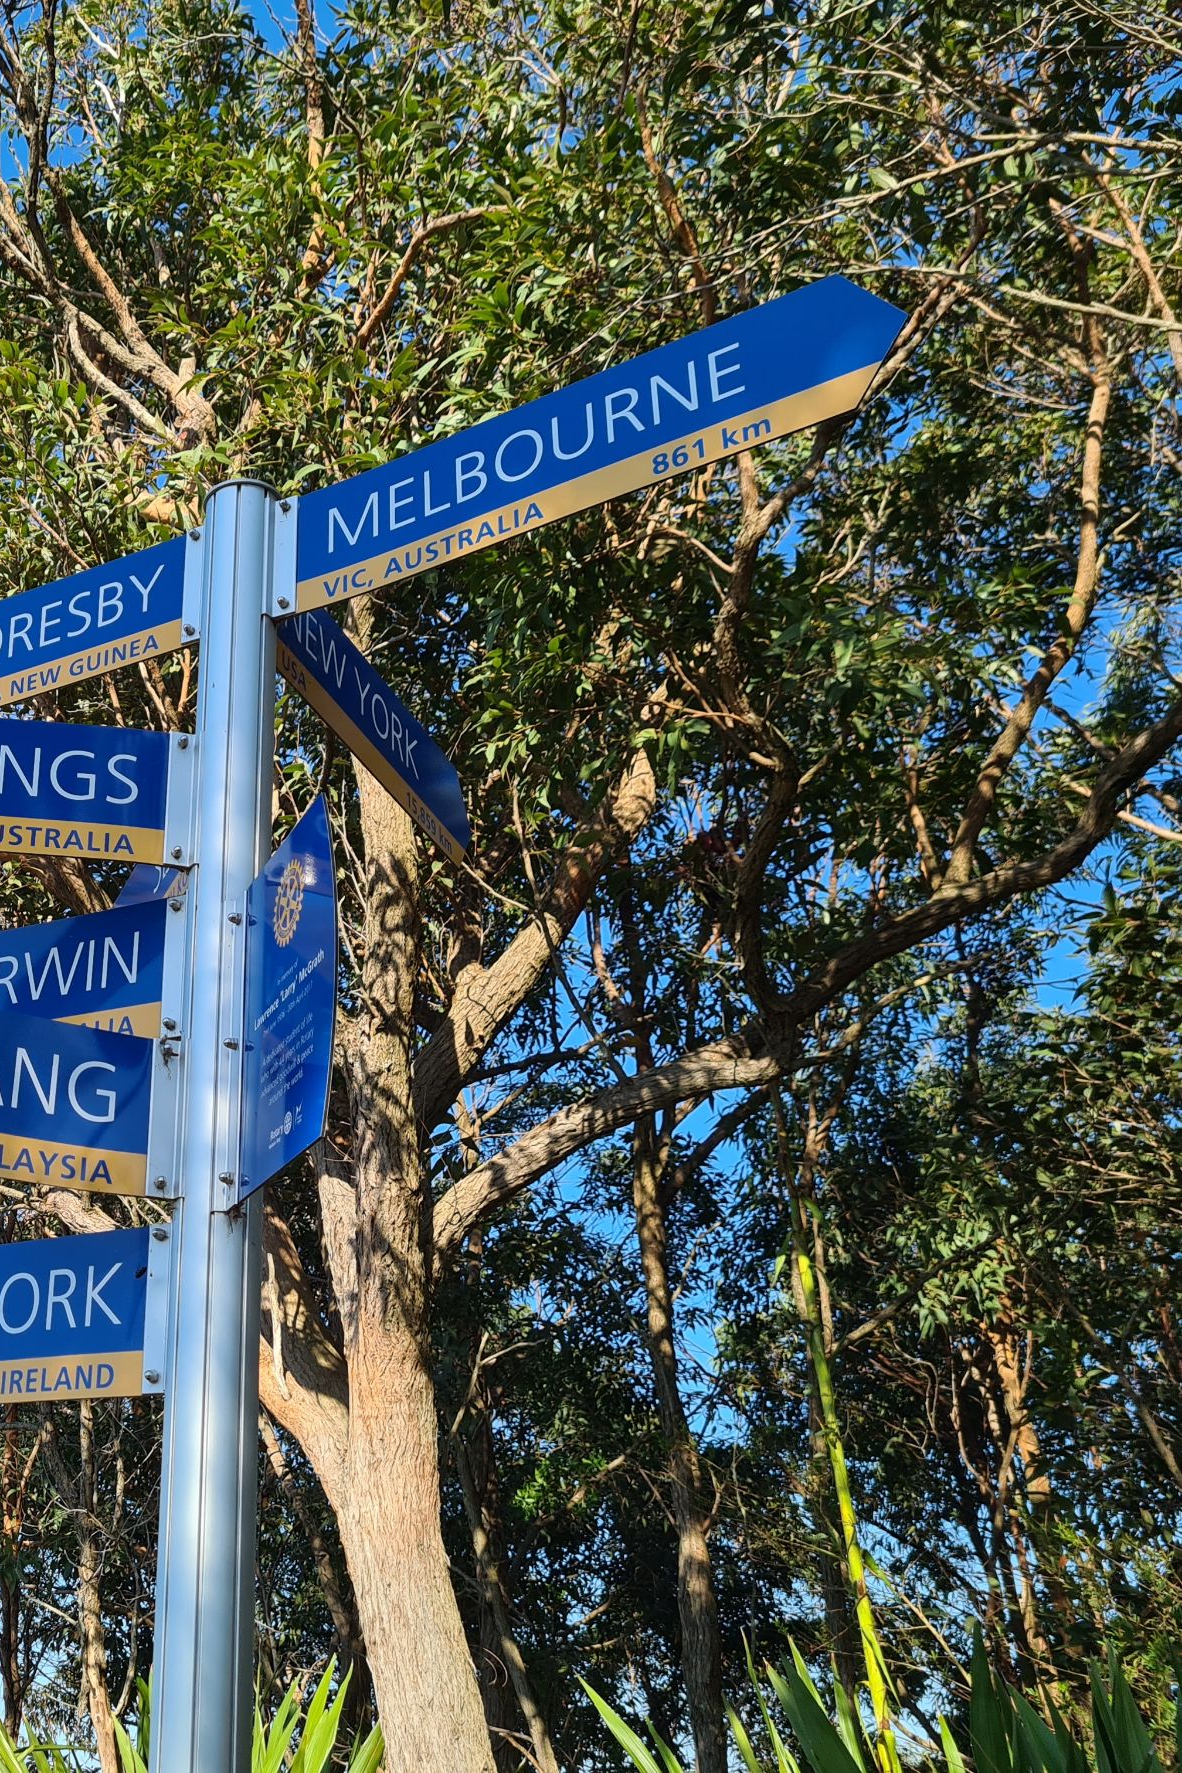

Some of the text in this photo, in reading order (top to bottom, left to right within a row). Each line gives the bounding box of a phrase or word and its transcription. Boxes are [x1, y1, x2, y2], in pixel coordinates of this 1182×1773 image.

[326, 341, 748, 554] MELBOURNE
[652, 413, 772, 476] 861 km
[322, 501, 545, 599] VIC, AUSTRALIA
[10, 664, 62, 697] NEW
[69, 634, 160, 677] GUINEA
[281, 647, 307, 692] USA
[354, 665, 420, 781] YORK
[438, 824, 453, 855] km
[254, 998, 279, 1031] Lawrence
[298, 947, 325, 984] McGrath
[0, 1363, 115, 1395] IRELAND
